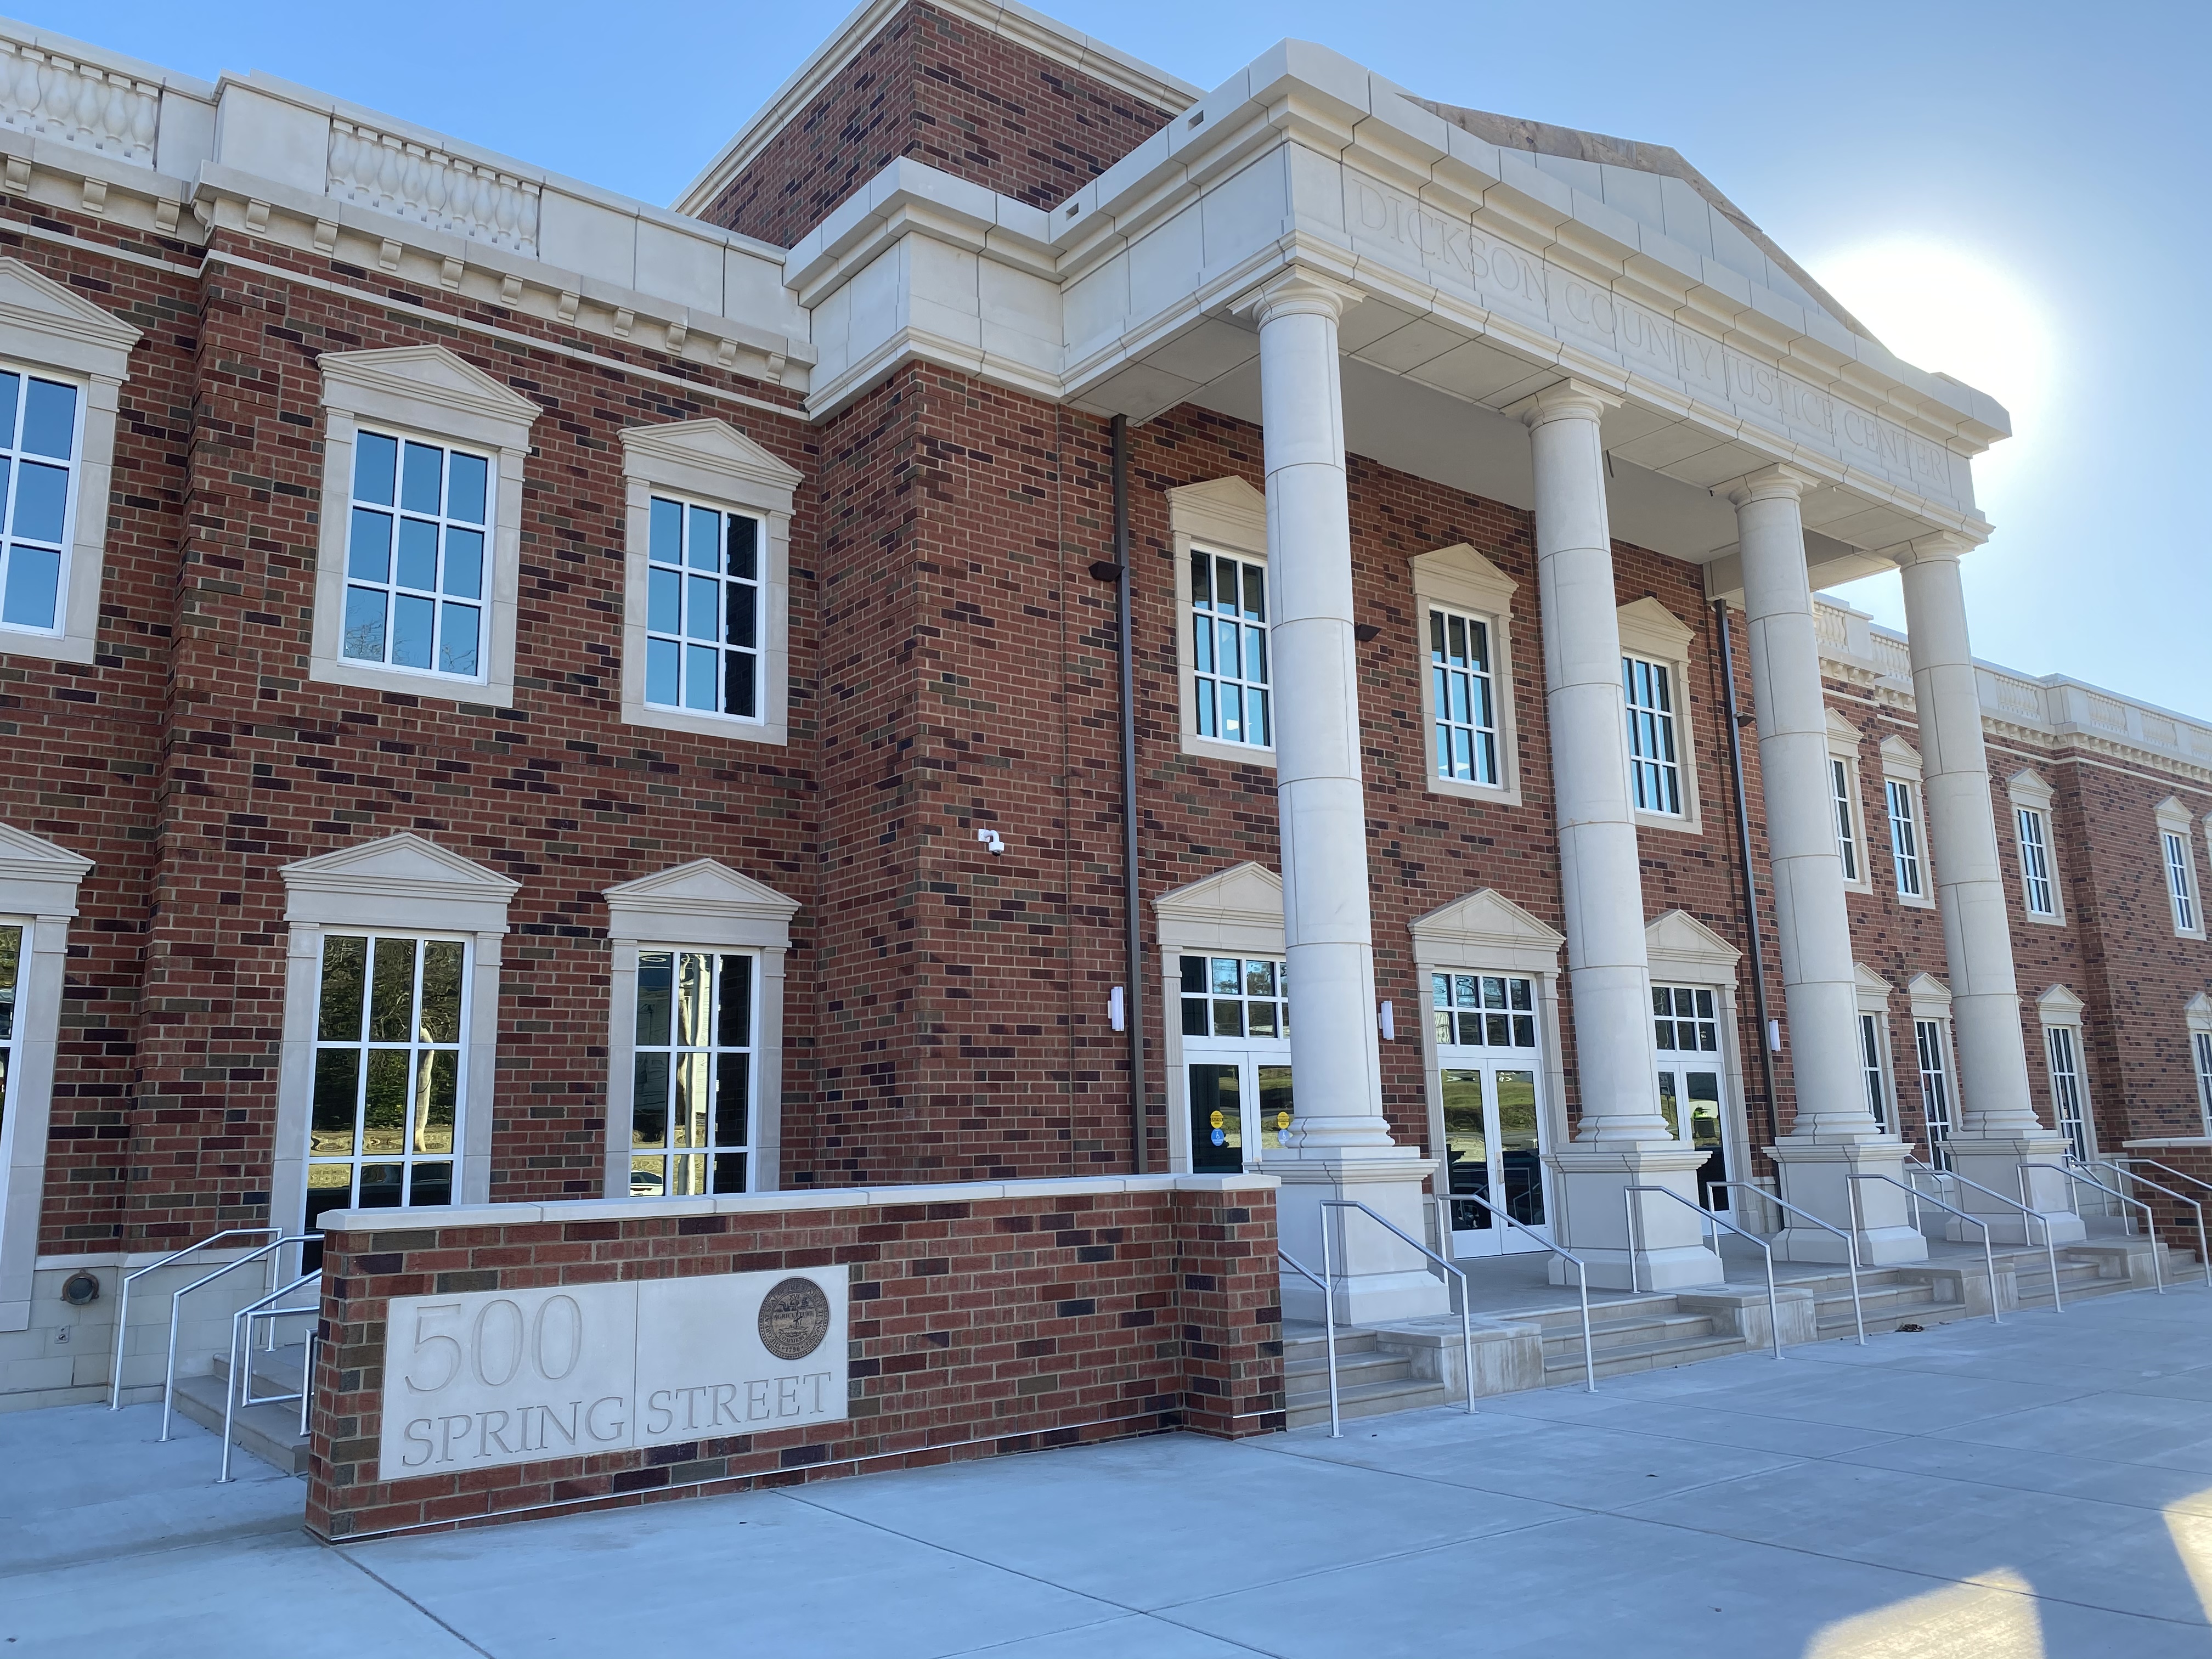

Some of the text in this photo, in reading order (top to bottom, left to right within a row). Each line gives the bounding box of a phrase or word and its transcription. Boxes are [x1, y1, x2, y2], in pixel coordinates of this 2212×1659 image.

[1352, 178, 1946, 484] DICKSON COUNTY JUSTICE CENTER
[777, 1287, 785, 1295] OF
[802, 1284, 817, 1300] STATE
[766, 1295, 779, 1312] SEAL
[816, 1299, 823, 1309] OF
[765, 1313, 774, 1339] GREAT
[804, 1310, 823, 1348] TENNESSEE
[404, 1295, 582, 1395] 500
[770, 1339, 781, 1350] THE
[402, 1372, 831, 1468] SPRING STREET
